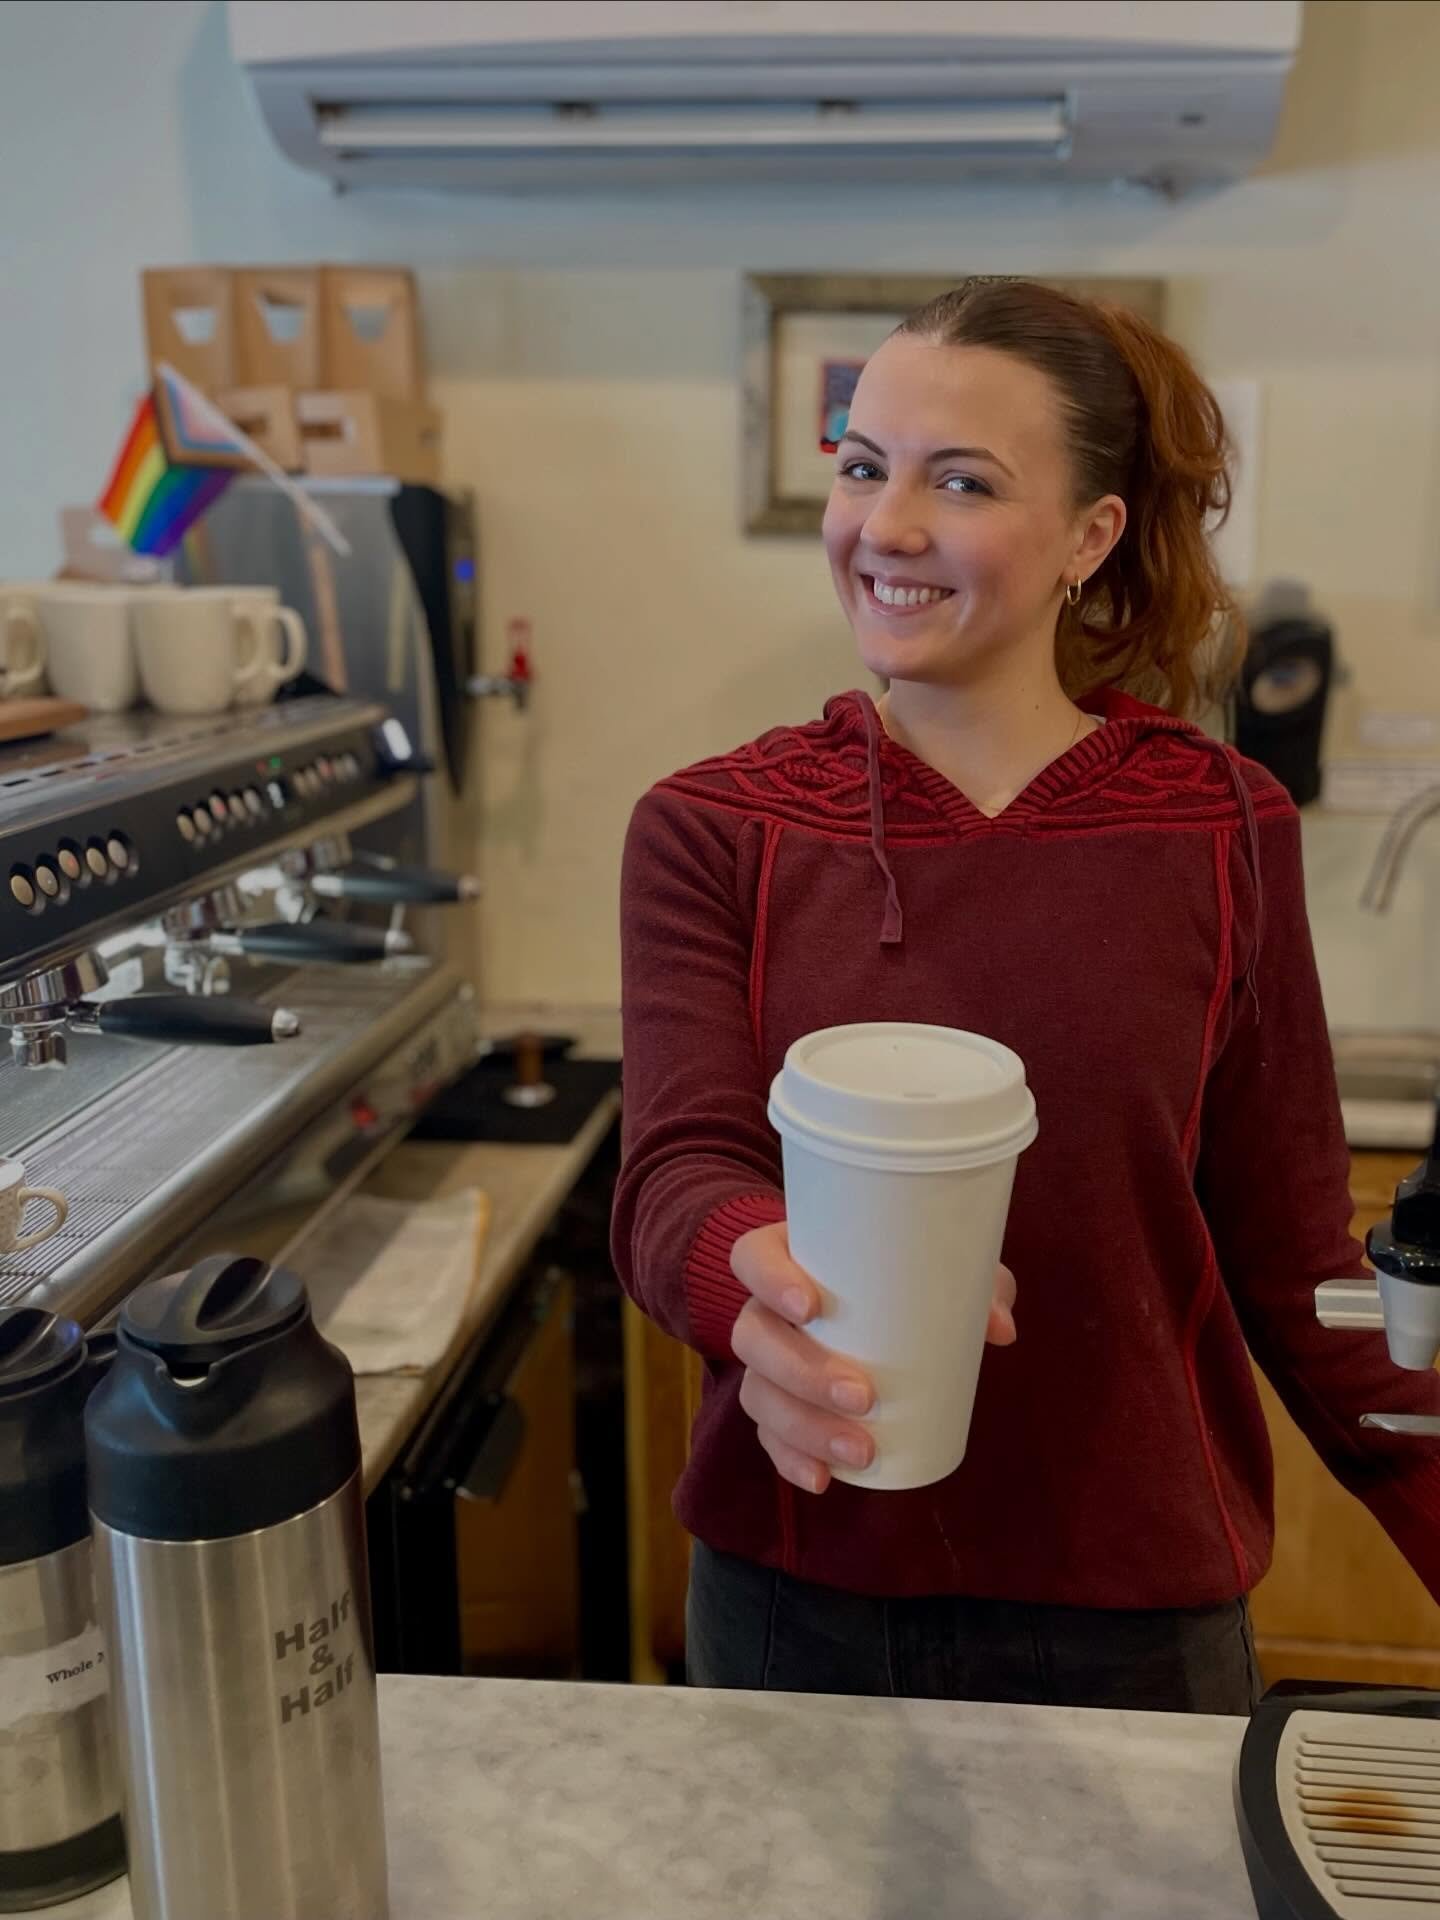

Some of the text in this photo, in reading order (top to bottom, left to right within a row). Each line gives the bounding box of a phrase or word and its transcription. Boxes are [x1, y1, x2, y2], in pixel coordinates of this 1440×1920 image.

[275, 1589, 351, 1660] Half
[46, 1660, 94, 1684] Whole
[309, 1643, 334, 1675] &
[281, 1652, 353, 1724] Half
